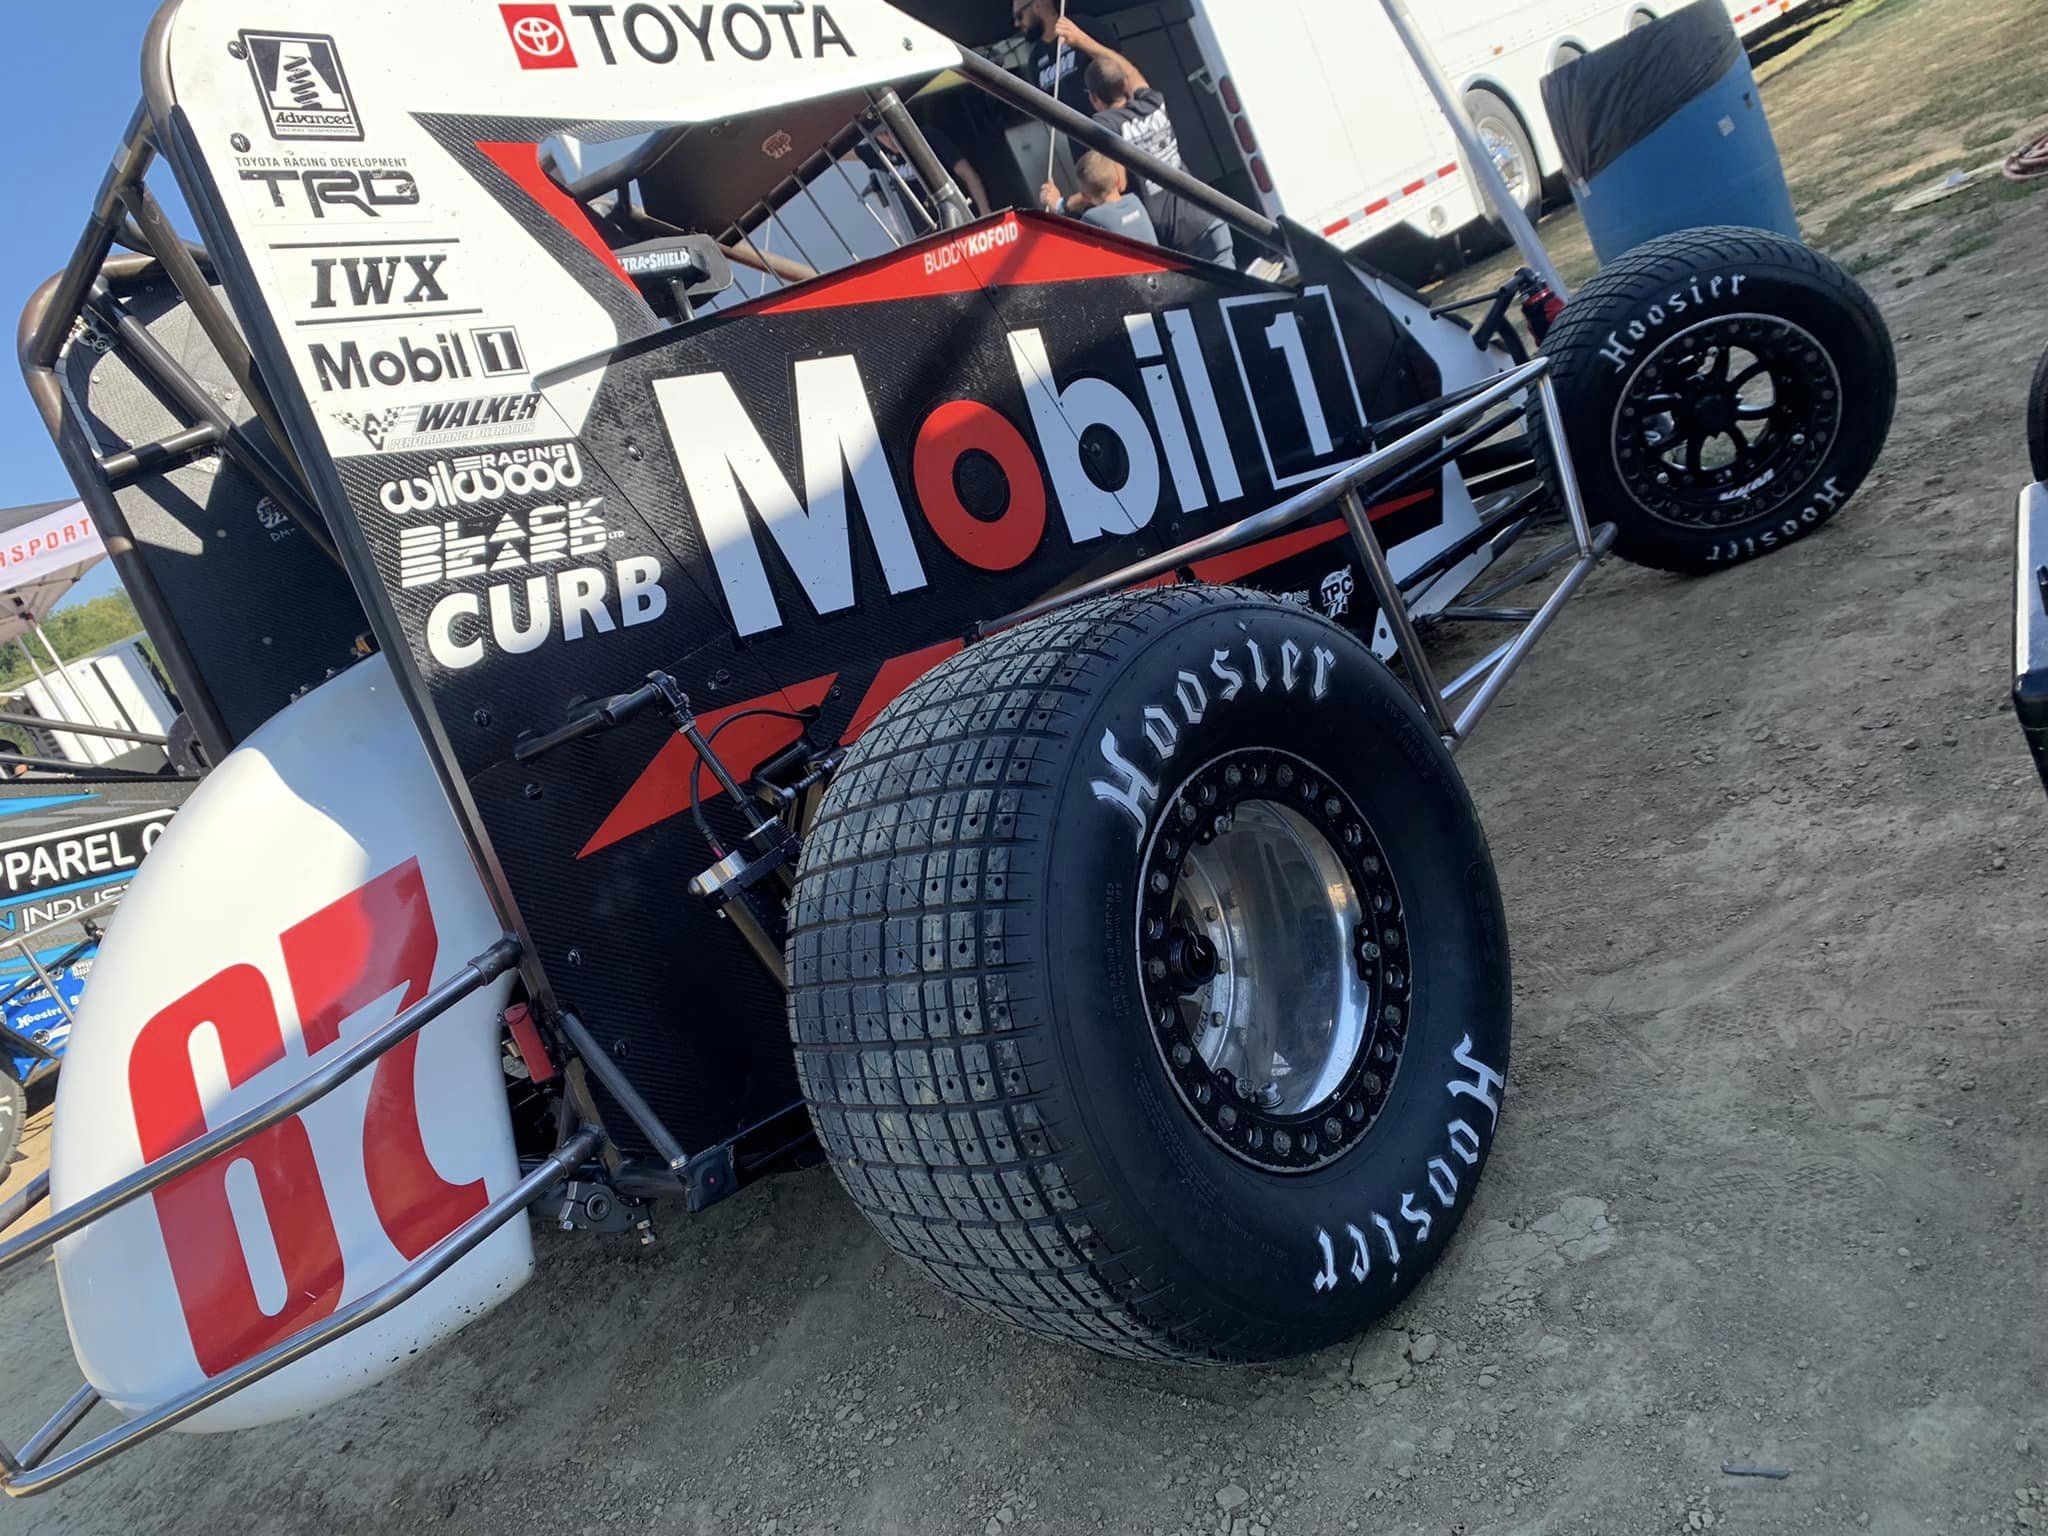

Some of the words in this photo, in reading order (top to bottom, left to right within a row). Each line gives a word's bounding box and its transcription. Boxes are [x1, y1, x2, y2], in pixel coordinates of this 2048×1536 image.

[569, 3, 857, 65] TOYOTA
[275, 112, 353, 125] Advanced
[235, 156, 280, 168] TOYOTA
[283, 156, 326, 168] RACING
[330, 157, 408, 168] DEVELOPMENT
[238, 170, 420, 218] TRD
[311, 254, 449, 308] IWX
[1600, 274, 1746, 373] Hoosier
[308, 330, 472, 392] Mobil
[416, 394, 542, 432] WALKER
[482, 444, 566, 467] RACING
[652, 309, 1243, 637] Mobil
[1265, 312, 1334, 457] 1
[1706, 475, 1846, 560] Hoosier
[427, 555, 668, 669] CURB
[1090, 619, 1337, 853] Hoosier
[0, 829, 136, 890] PAREL
[128, 855, 490, 1378] 67
[1312, 1032, 1505, 1292] Hoosier
